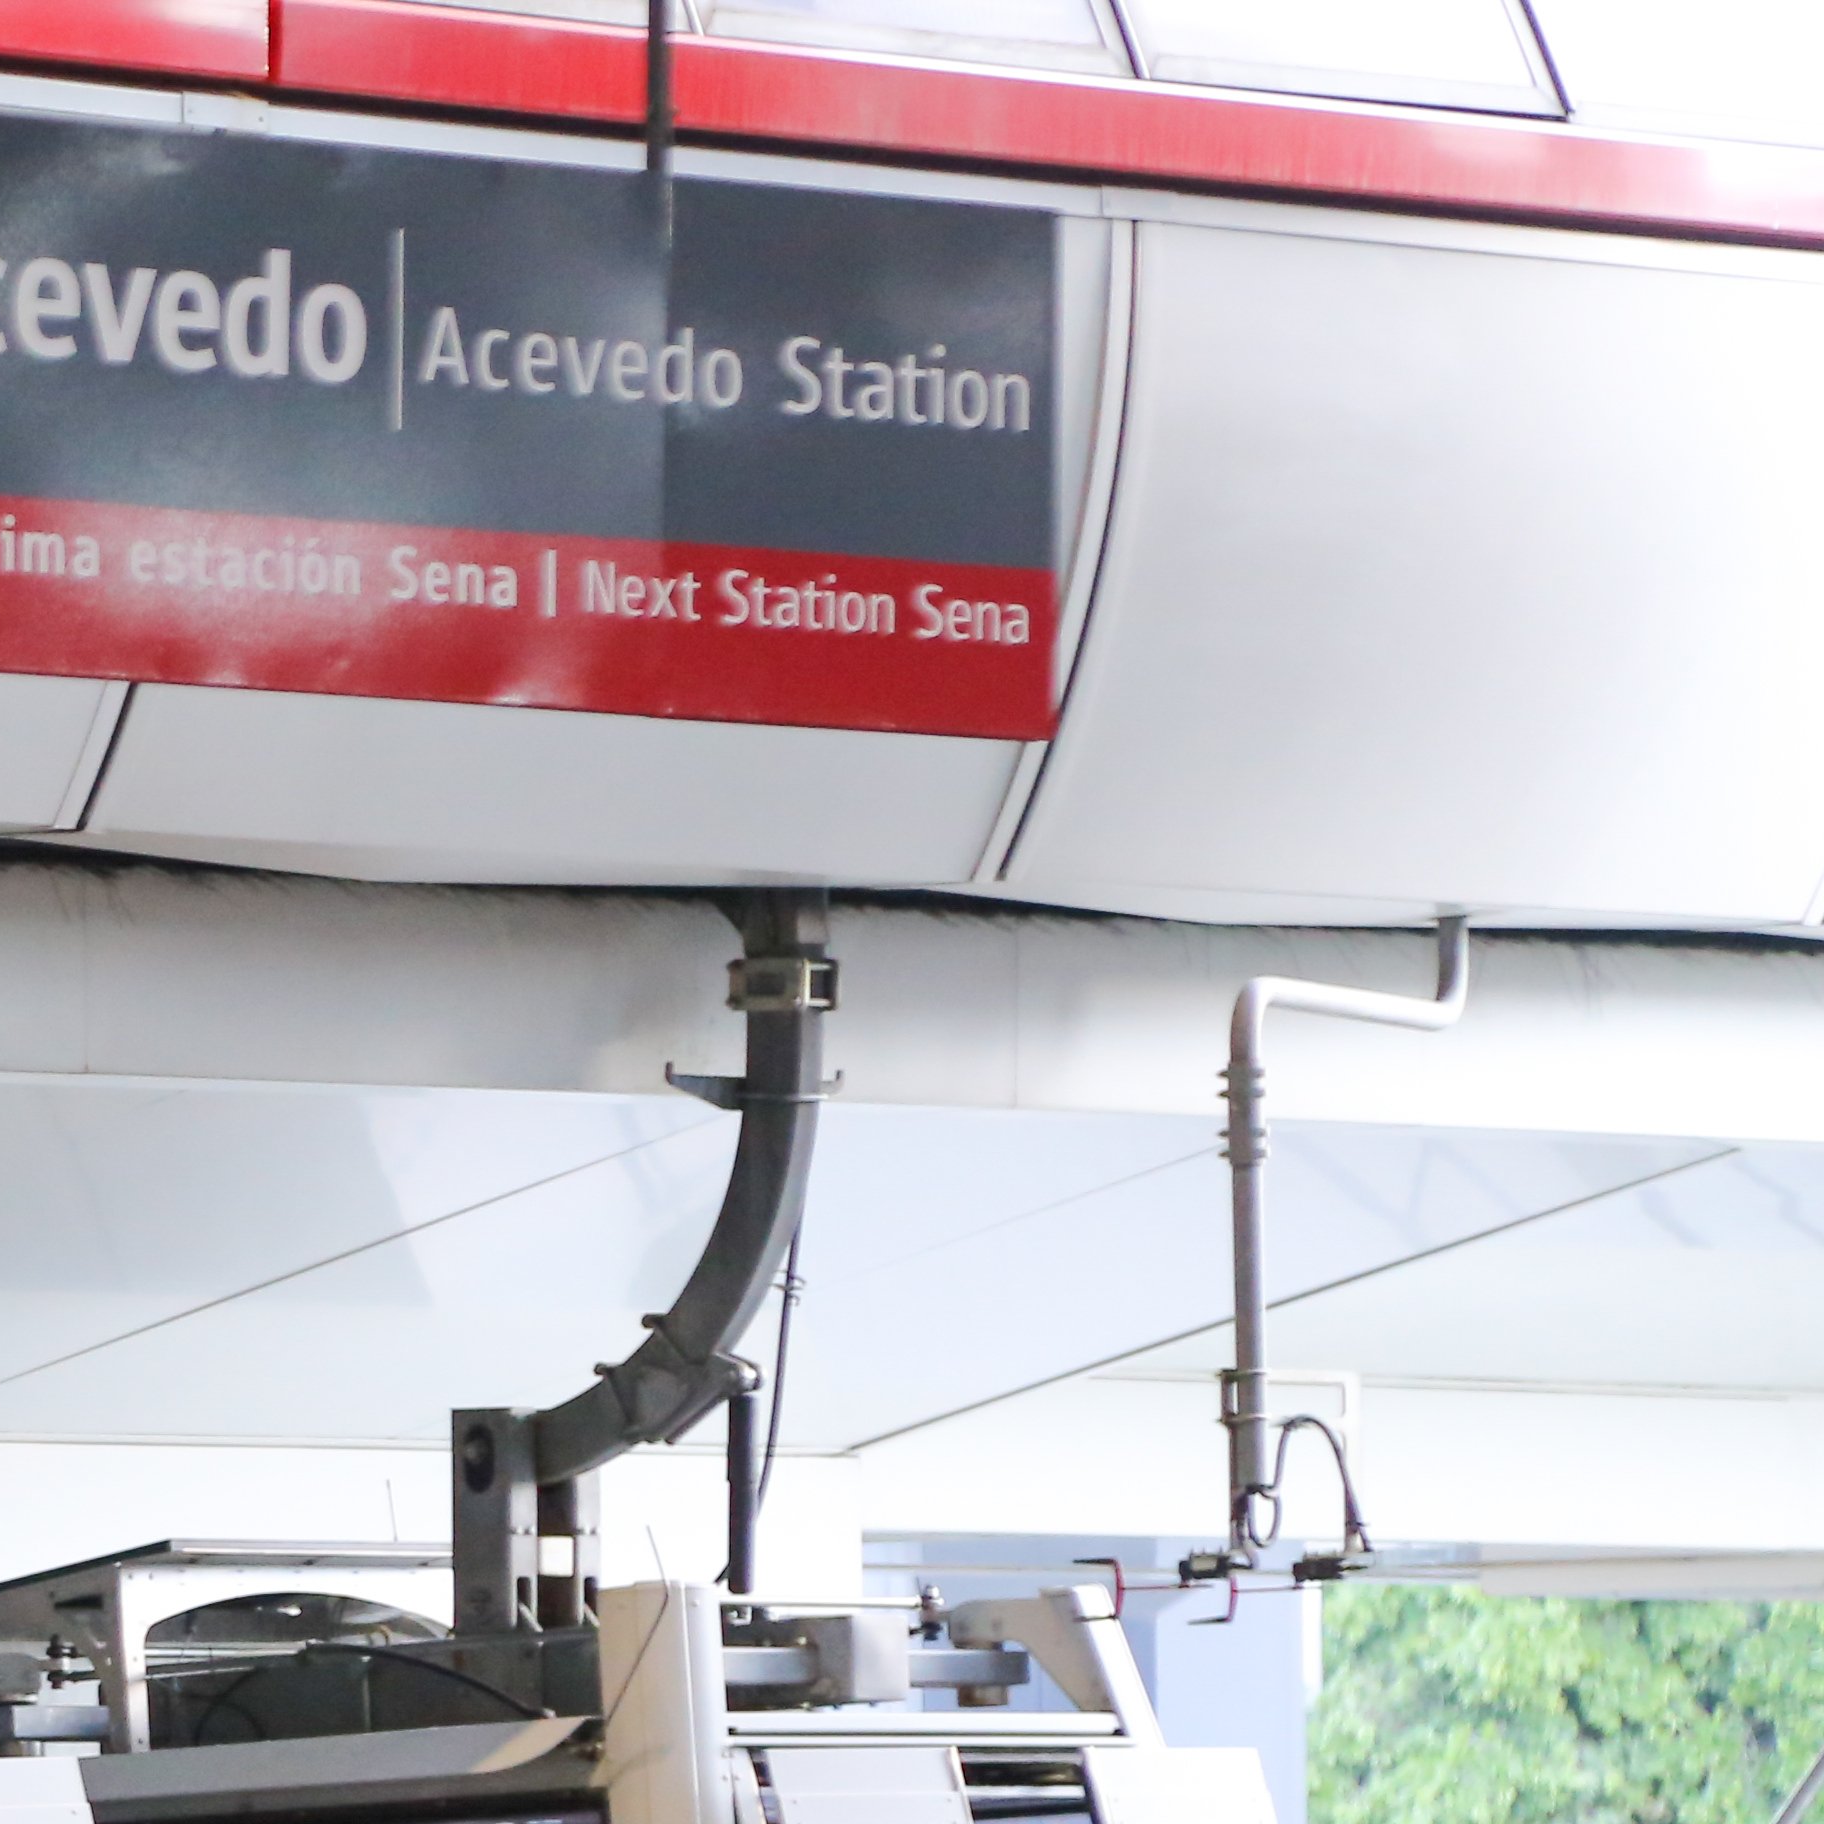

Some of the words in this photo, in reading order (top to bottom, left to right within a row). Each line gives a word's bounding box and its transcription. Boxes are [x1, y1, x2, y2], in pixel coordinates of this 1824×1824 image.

[420, 305, 744, 408] Acevedo
[779, 335, 1031, 432] Station
[128, 534, 362, 597] estación
[387, 545, 519, 607] Sena
[583, 559, 702, 622] Next
[719, 568, 897, 634] Station
[913, 583, 1031, 645] Sena
